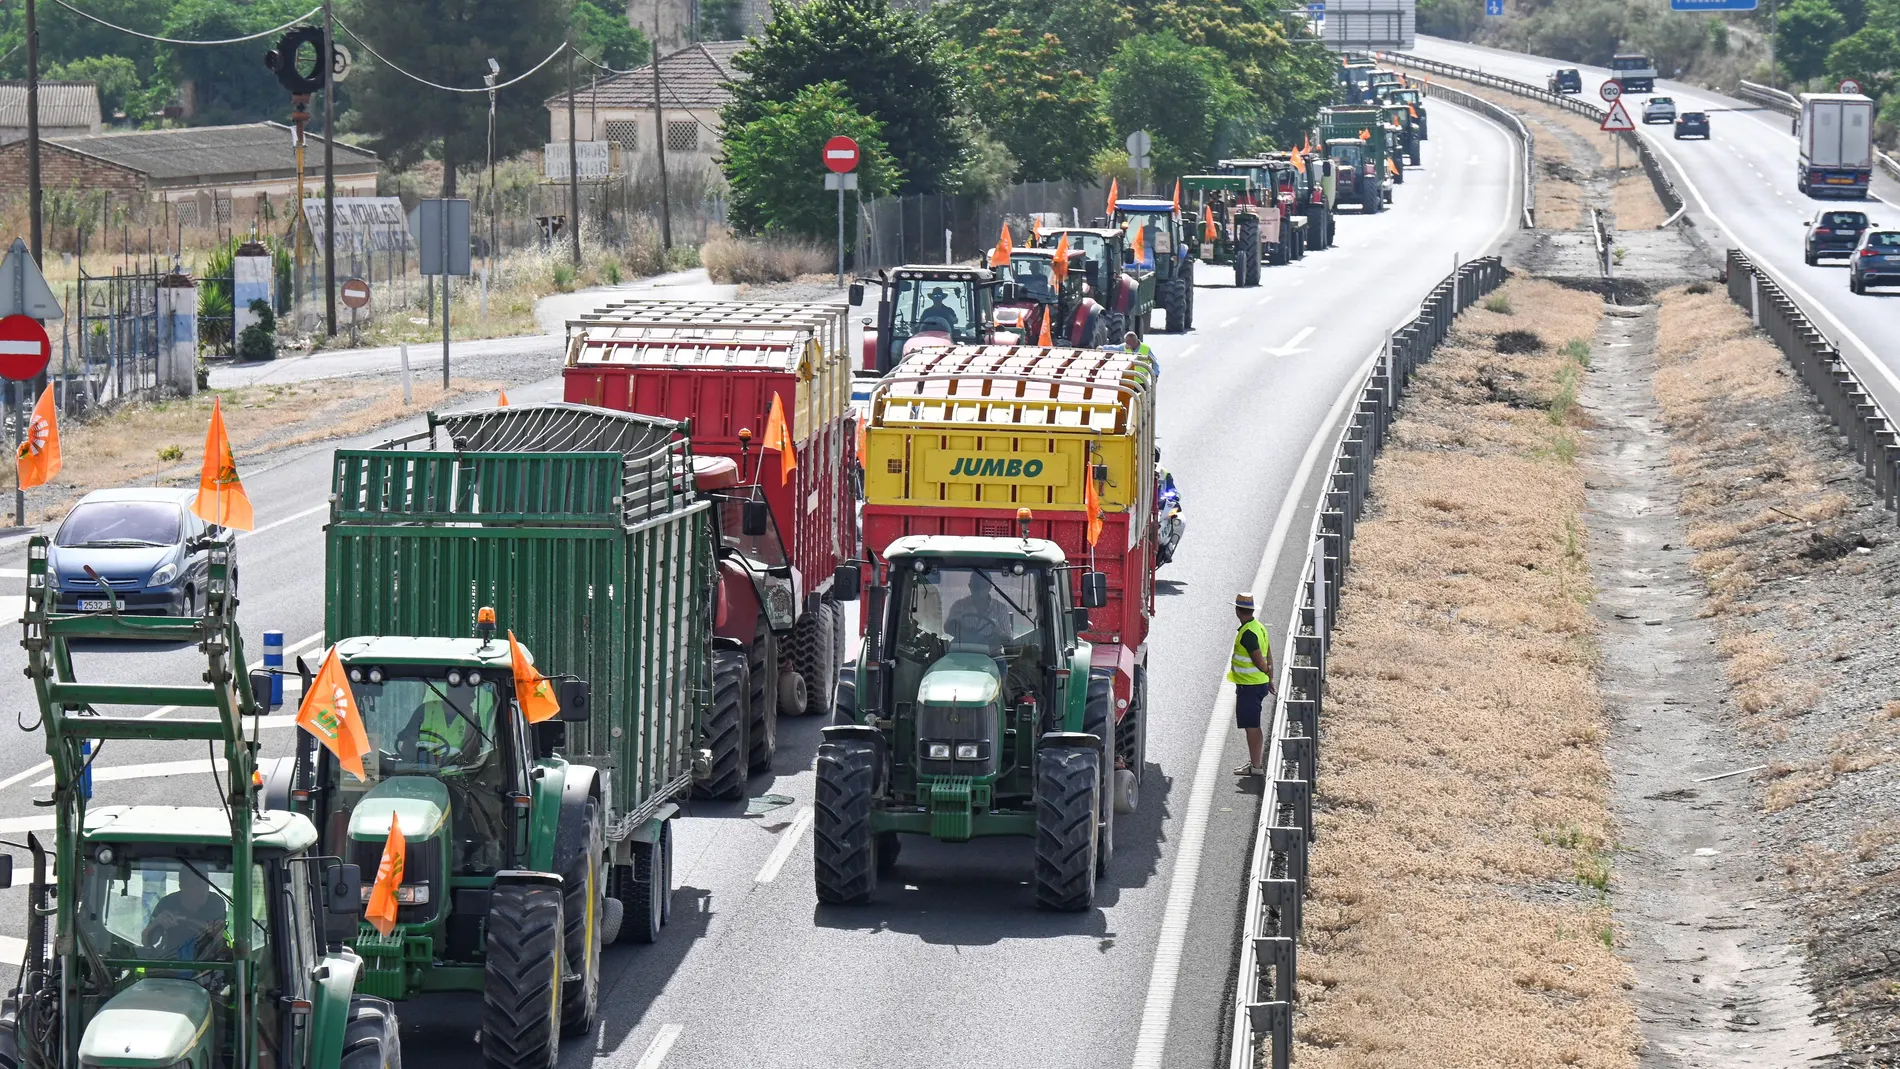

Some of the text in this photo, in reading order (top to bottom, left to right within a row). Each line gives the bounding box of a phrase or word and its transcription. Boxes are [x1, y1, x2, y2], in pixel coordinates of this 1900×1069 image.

[1603, 87, 1618, 96] 120
[348, 203, 400, 225] MOVILES
[949, 457, 1044, 478] JUMBO
[83, 601, 103, 610] 2532
